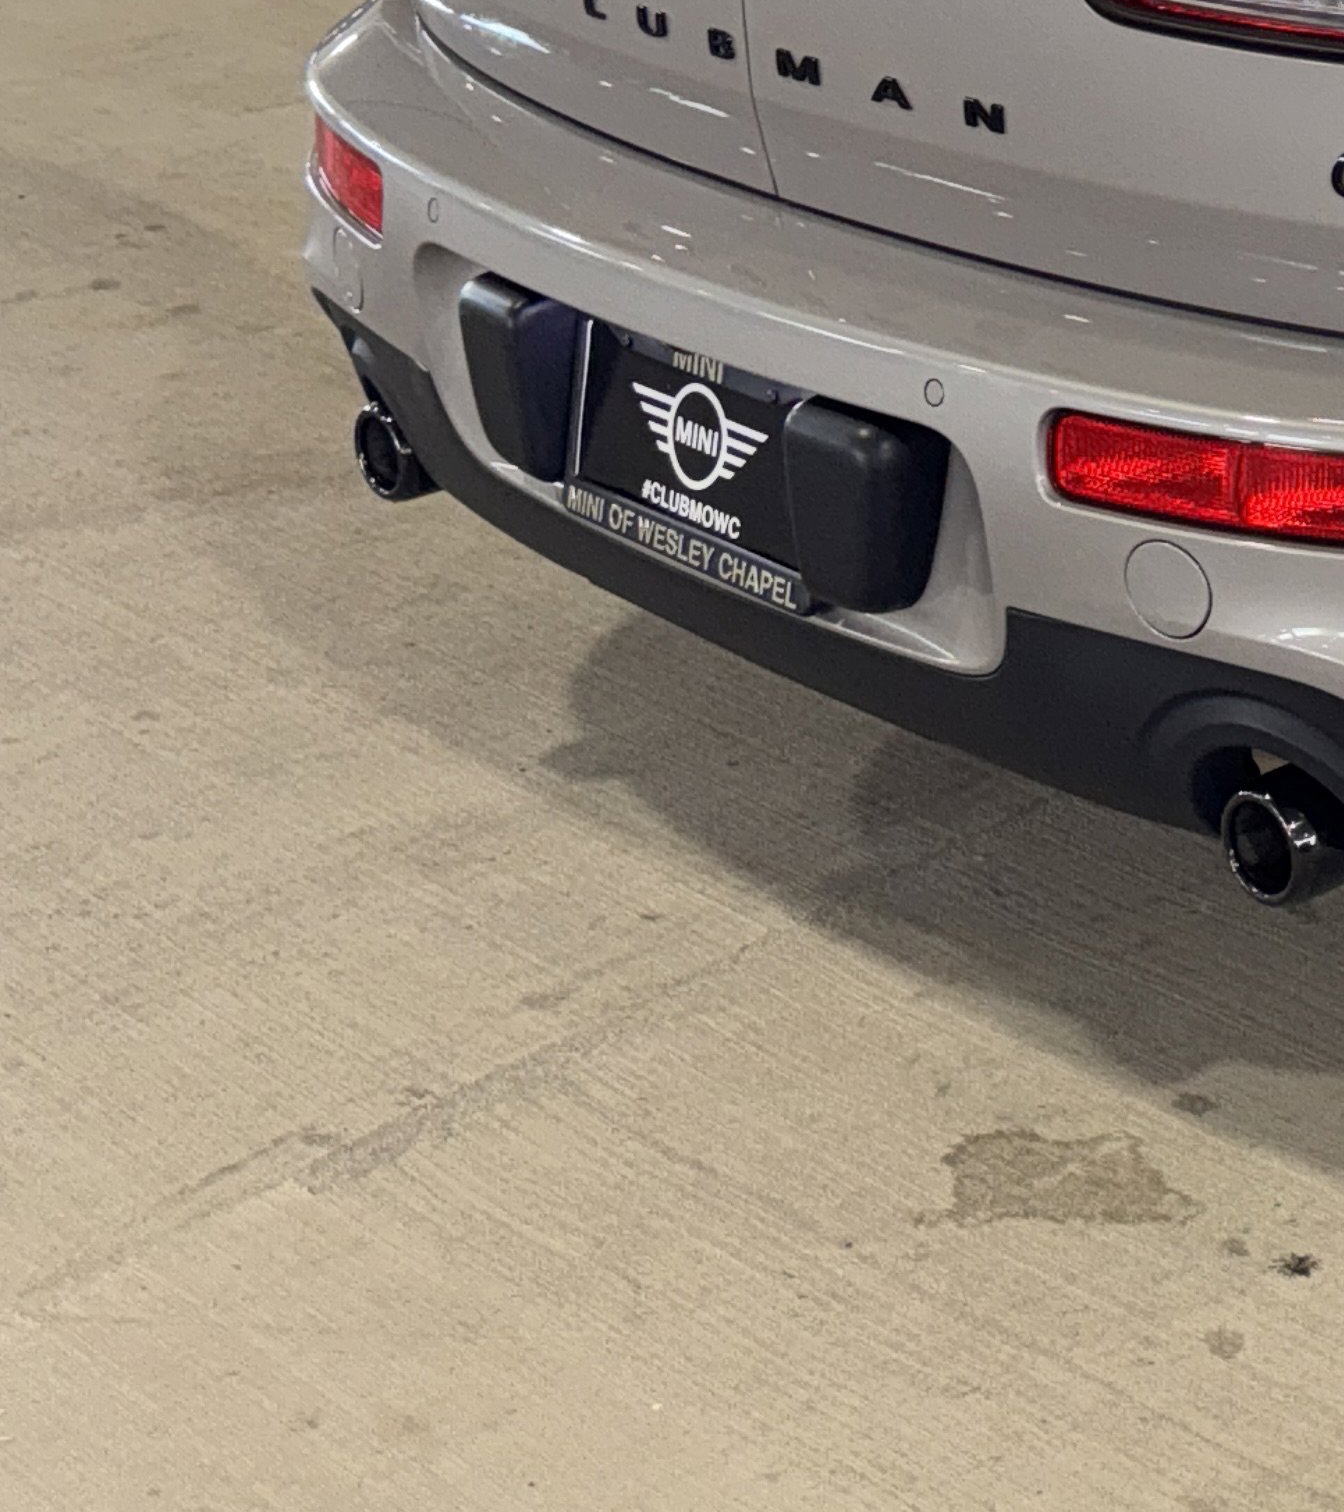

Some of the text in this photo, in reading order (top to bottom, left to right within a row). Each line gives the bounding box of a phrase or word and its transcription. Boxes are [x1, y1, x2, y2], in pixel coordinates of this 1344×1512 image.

[675, 416, 719, 457] MINI
[641, 479, 741, 539] #CLUBMOWC
[567, 486, 797, 608] MINI OF WESLEY CHAPEL
